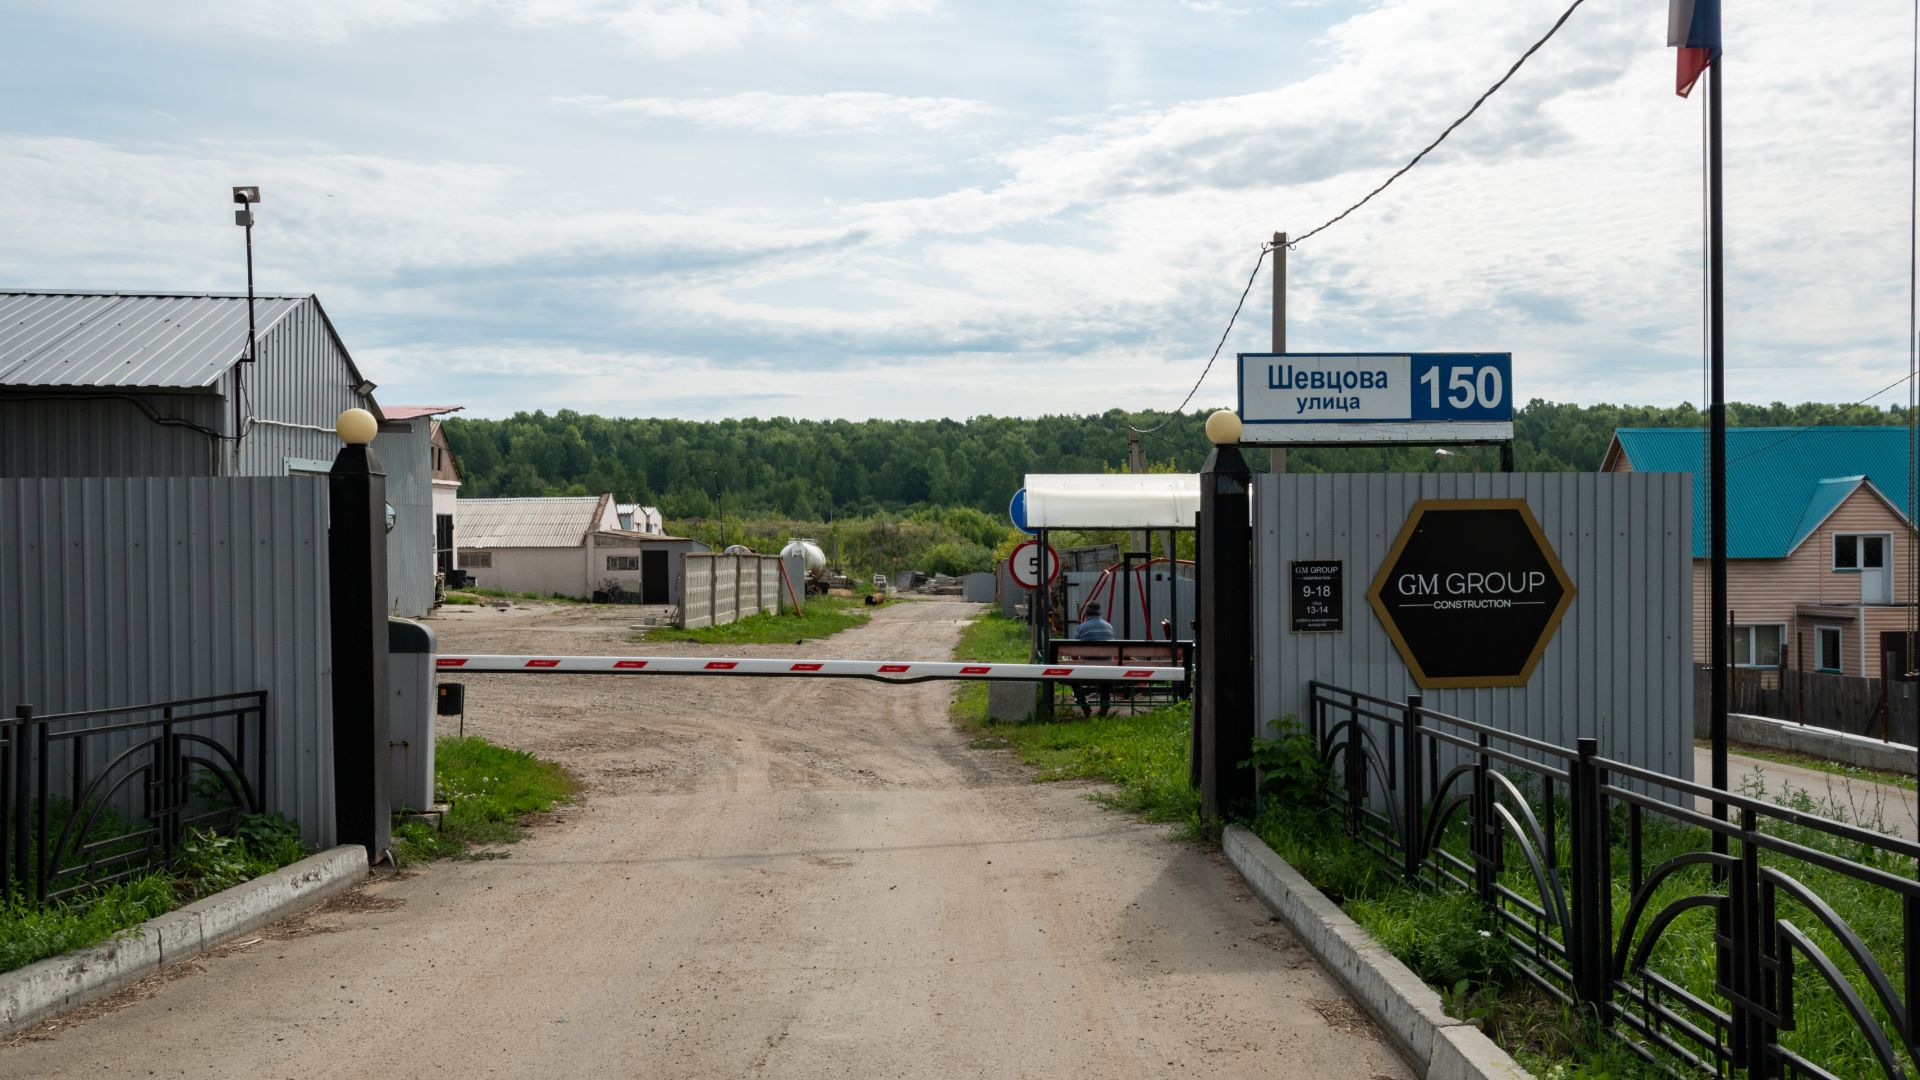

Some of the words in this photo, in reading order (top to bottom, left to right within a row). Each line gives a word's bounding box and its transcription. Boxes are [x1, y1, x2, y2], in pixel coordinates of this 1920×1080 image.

[1268, 365, 1388, 393] Шевцова
[1420, 365, 1503, 409] 150
[1296, 396, 1361, 413] улица
[1295, 566, 1309, 574] GM
[1310, 566, 1338, 574] GROUP
[1398, 573, 1440, 596] GM
[1445, 571, 1546, 595] GROUP
[1302, 585, 1331, 597] 9-18
[1306, 606, 1329, 614] 13-14
[1433, 599, 1512, 610] CONSTRUCTION
